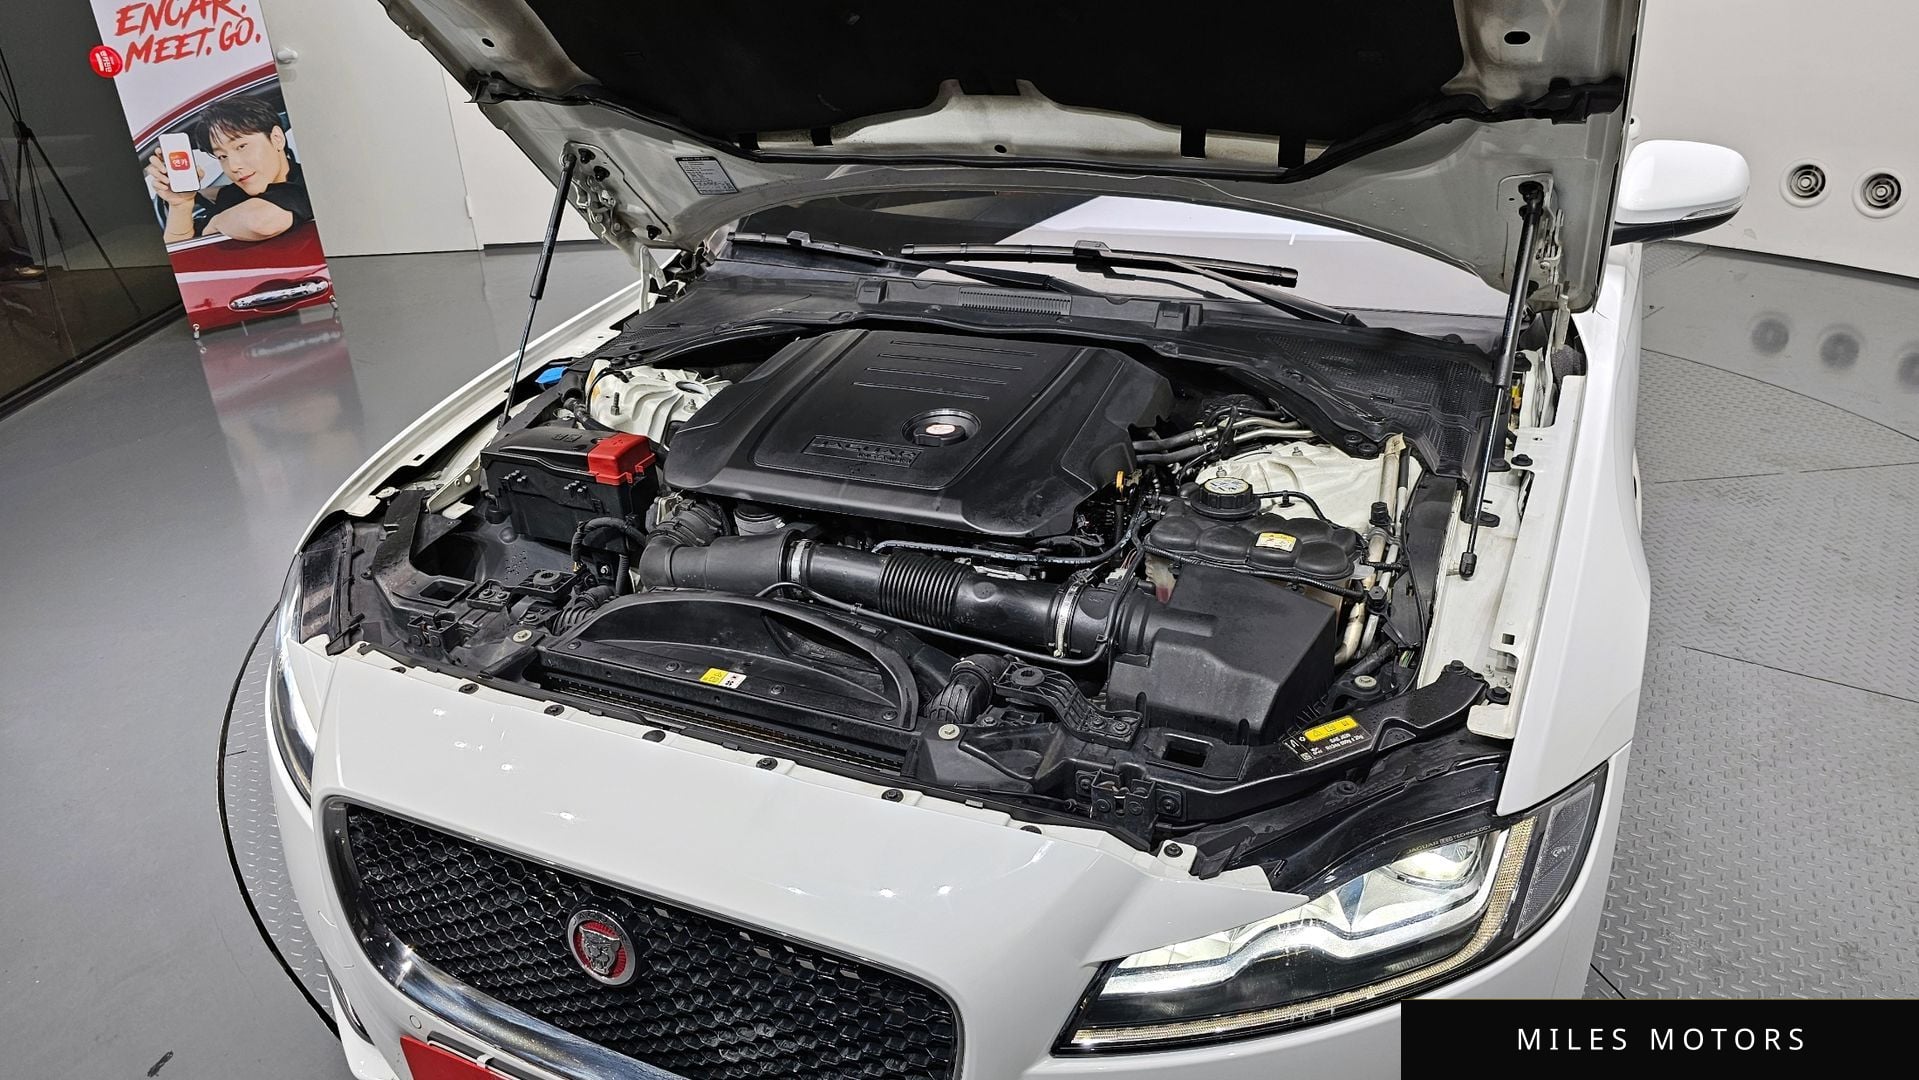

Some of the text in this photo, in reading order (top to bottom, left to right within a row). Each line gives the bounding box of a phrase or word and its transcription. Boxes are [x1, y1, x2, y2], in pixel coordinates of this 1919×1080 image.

[115, 0, 247, 36] ENCAR.
[125, 28, 215, 73] MEET.
[218, 17, 261, 52] GO.
[1406, 840, 1440, 855] JAGUAR
[1453, 825, 1492, 841] TECHNOLOGY
